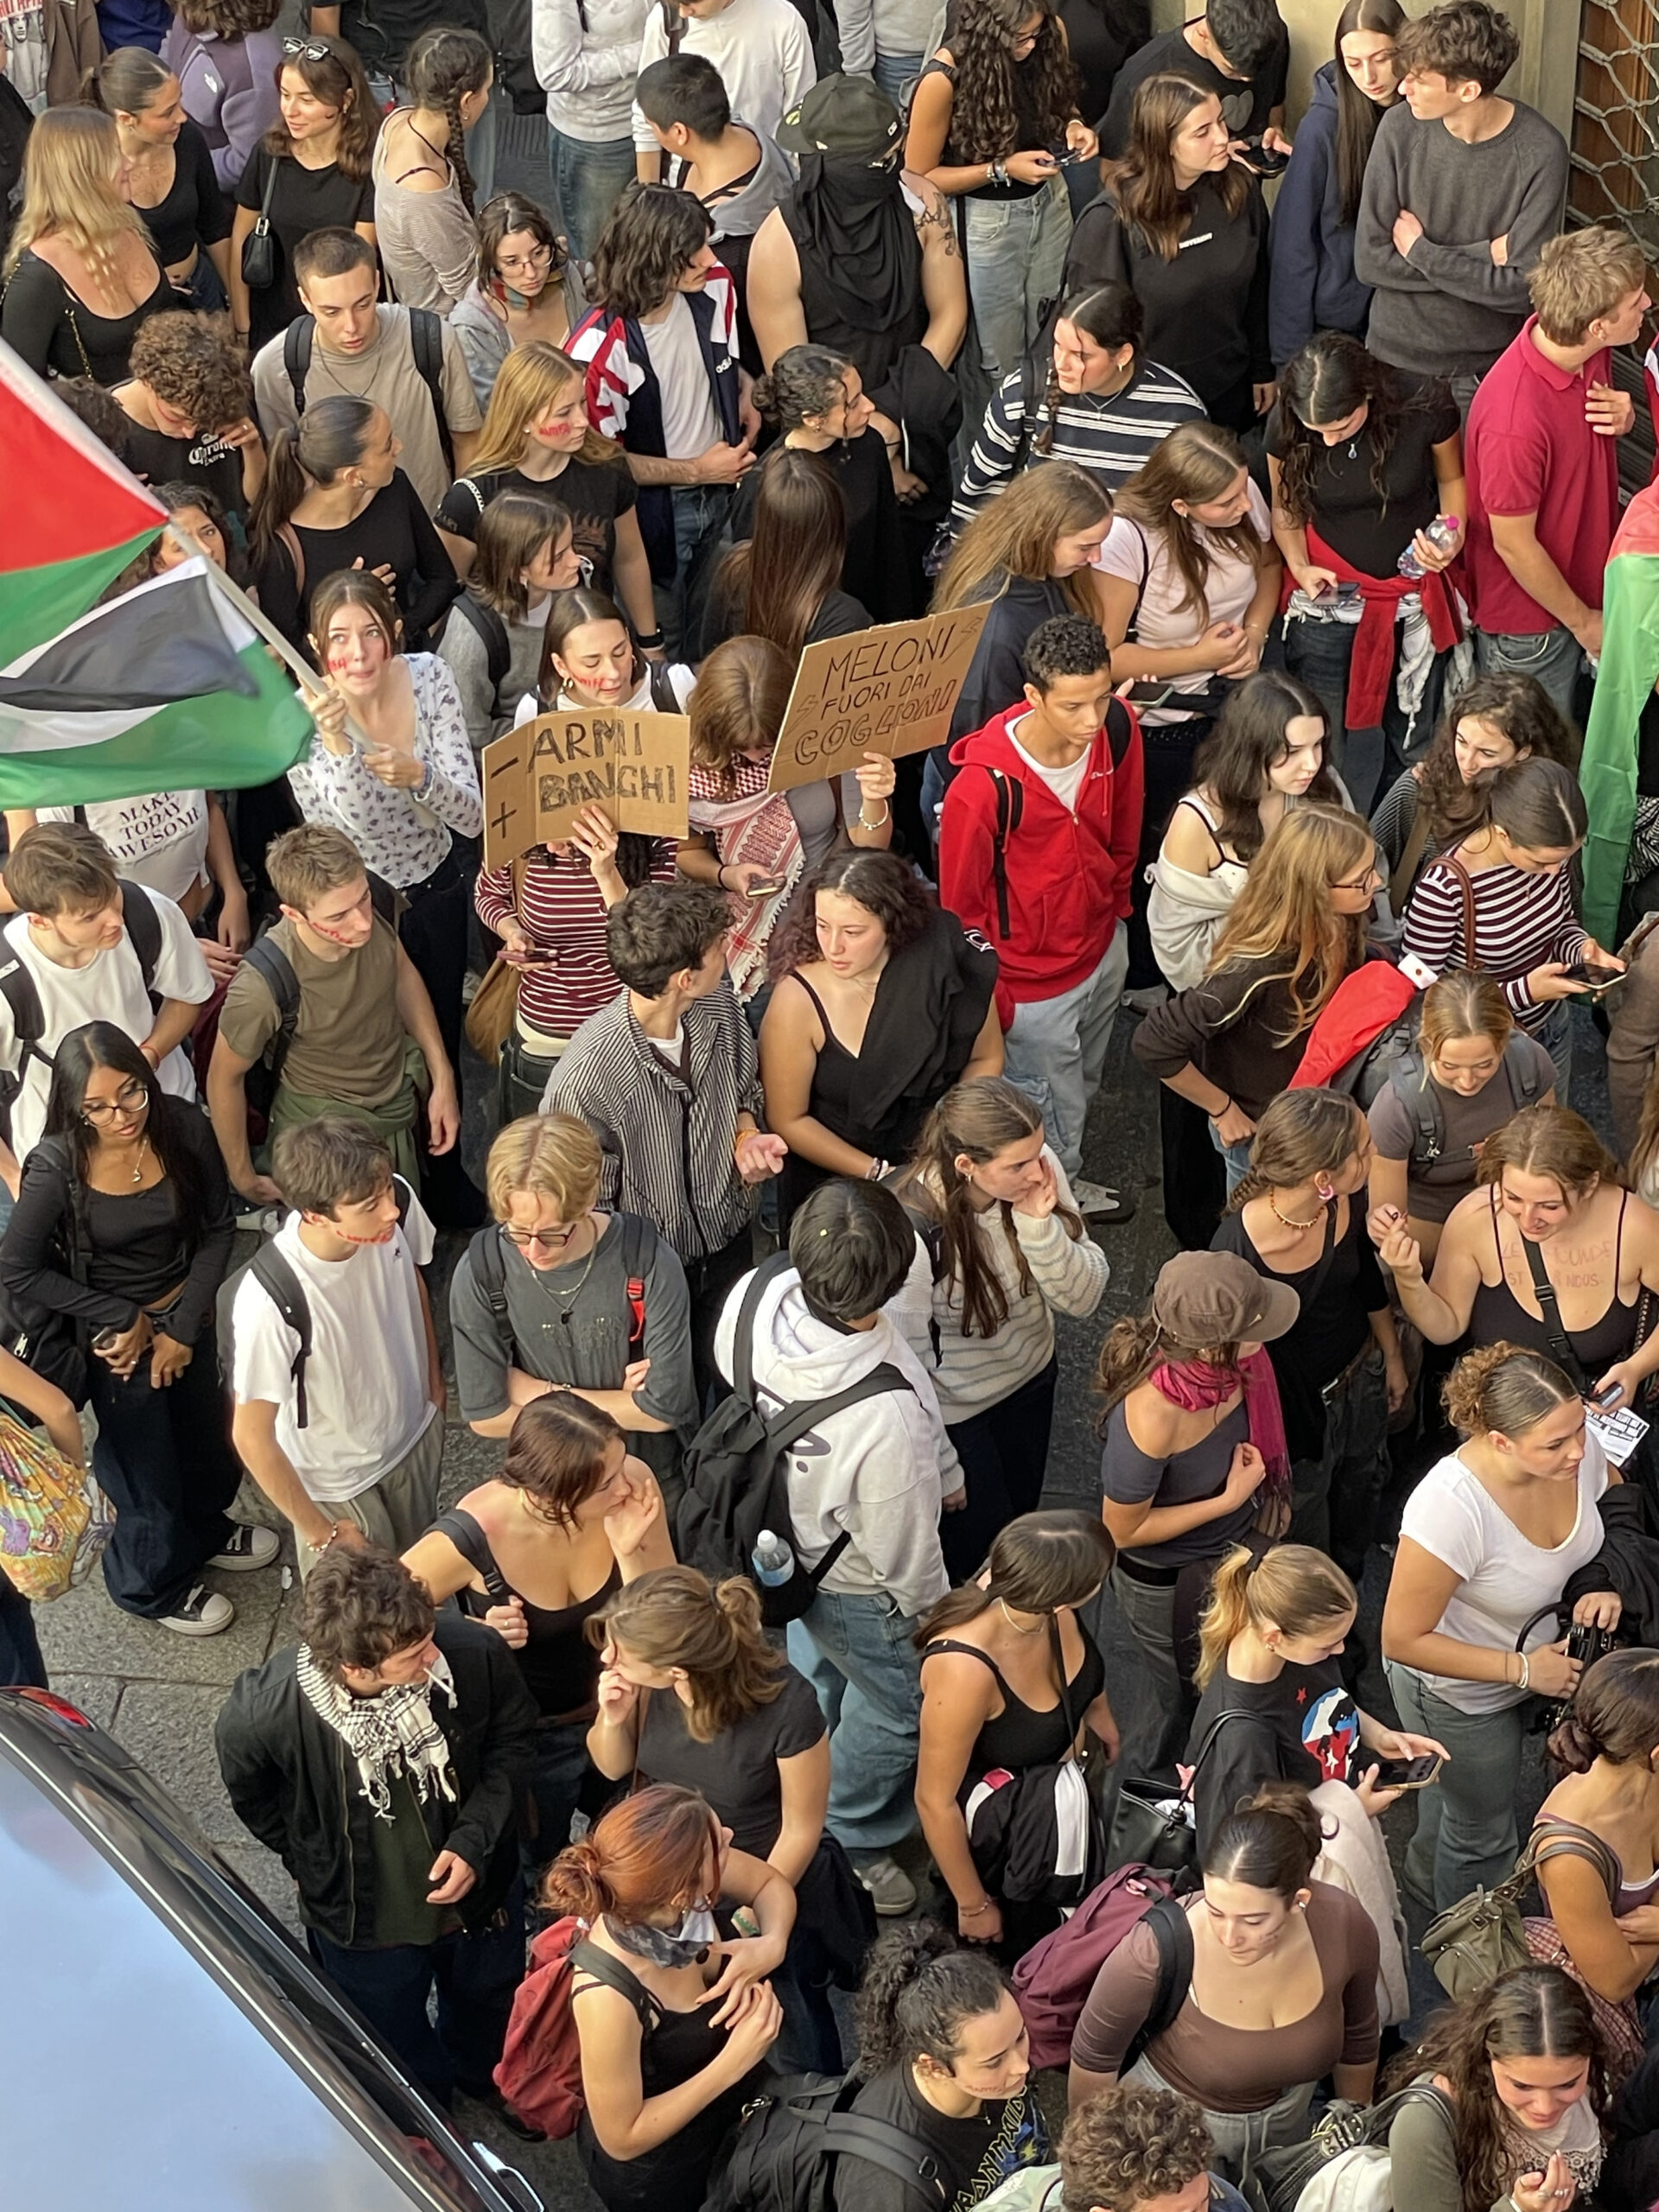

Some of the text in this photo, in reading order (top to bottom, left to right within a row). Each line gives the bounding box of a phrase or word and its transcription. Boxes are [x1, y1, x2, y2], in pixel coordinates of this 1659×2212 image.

[822, 622, 957, 699] MELONI
[794, 678, 957, 766] COGLIONI
[821, 671, 931, 721] FUORI DAI
[526, 718, 643, 774] ARMI
[119, 797, 181, 841] TODAY
[988, 2085, 1028, 2163] MAID
